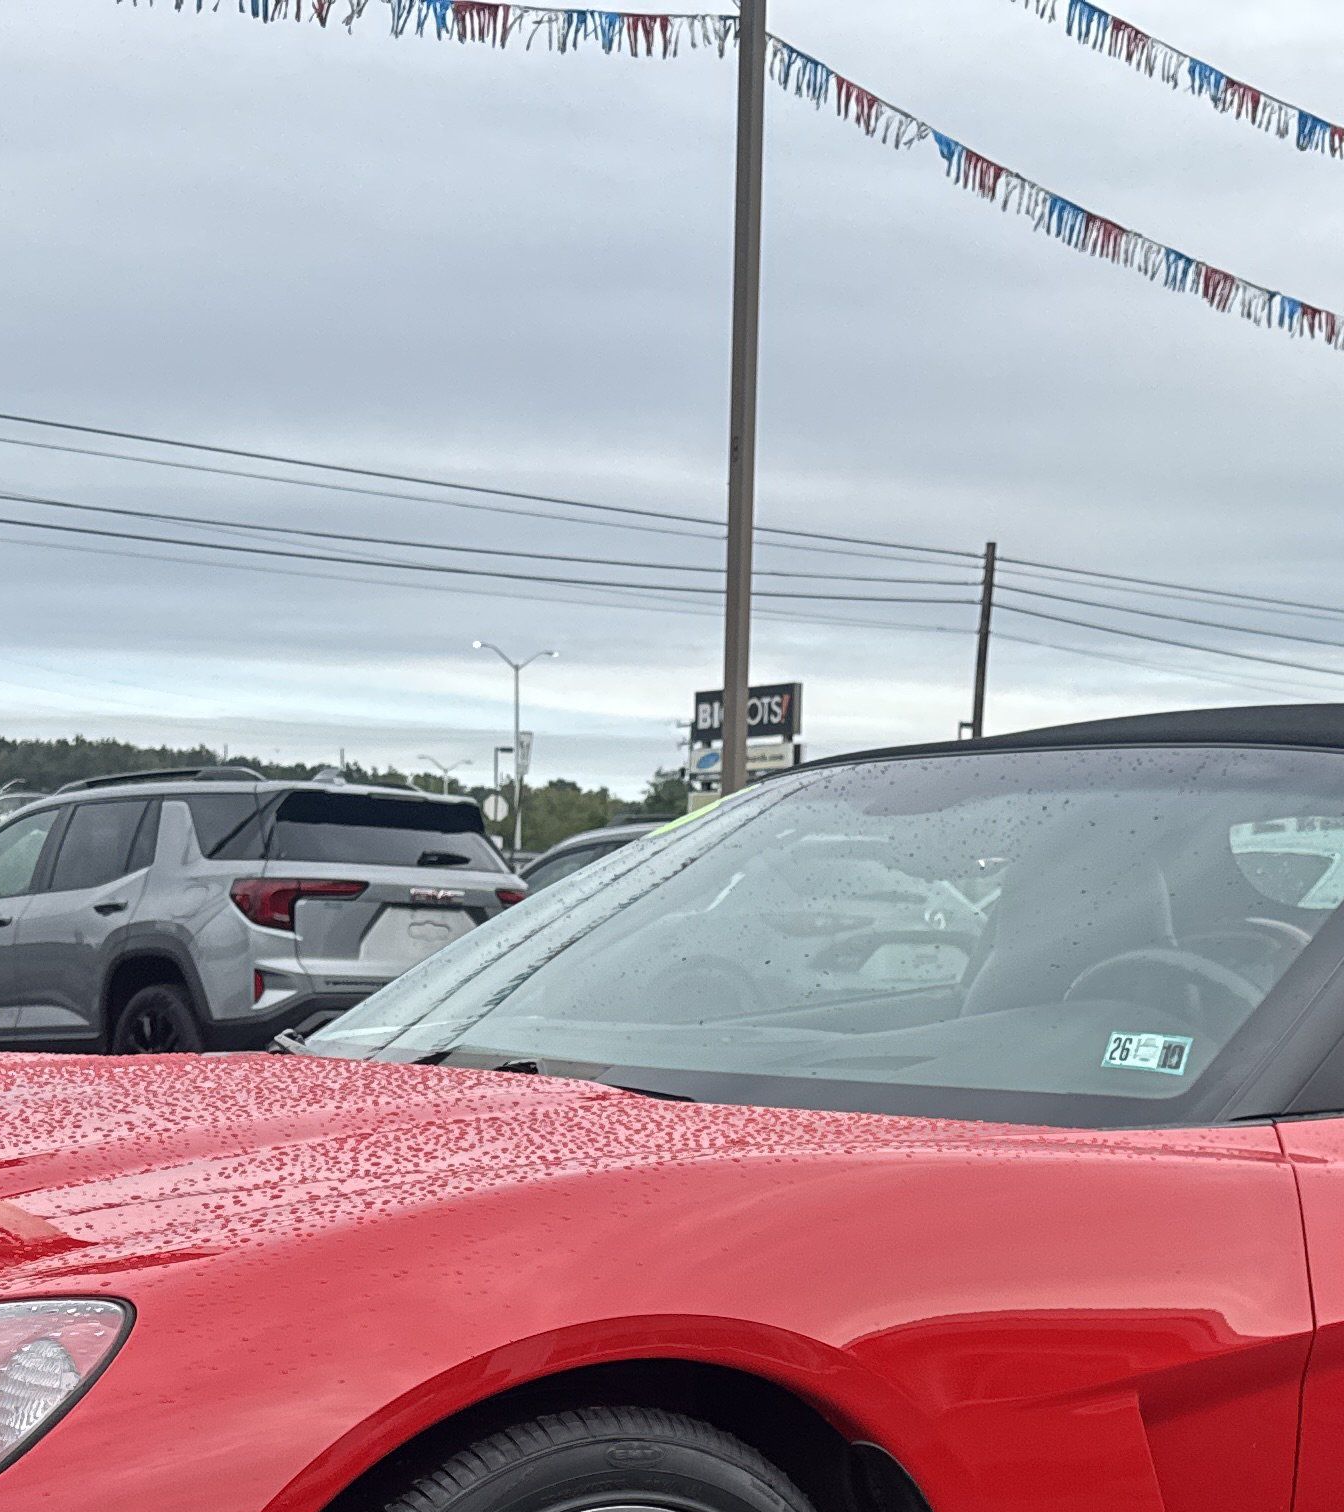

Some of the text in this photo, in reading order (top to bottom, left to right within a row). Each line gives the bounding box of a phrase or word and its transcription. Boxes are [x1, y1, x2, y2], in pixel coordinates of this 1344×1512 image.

[697, 693, 791, 730] BI OTS!
[1108, 1036, 1133, 1062] 26
